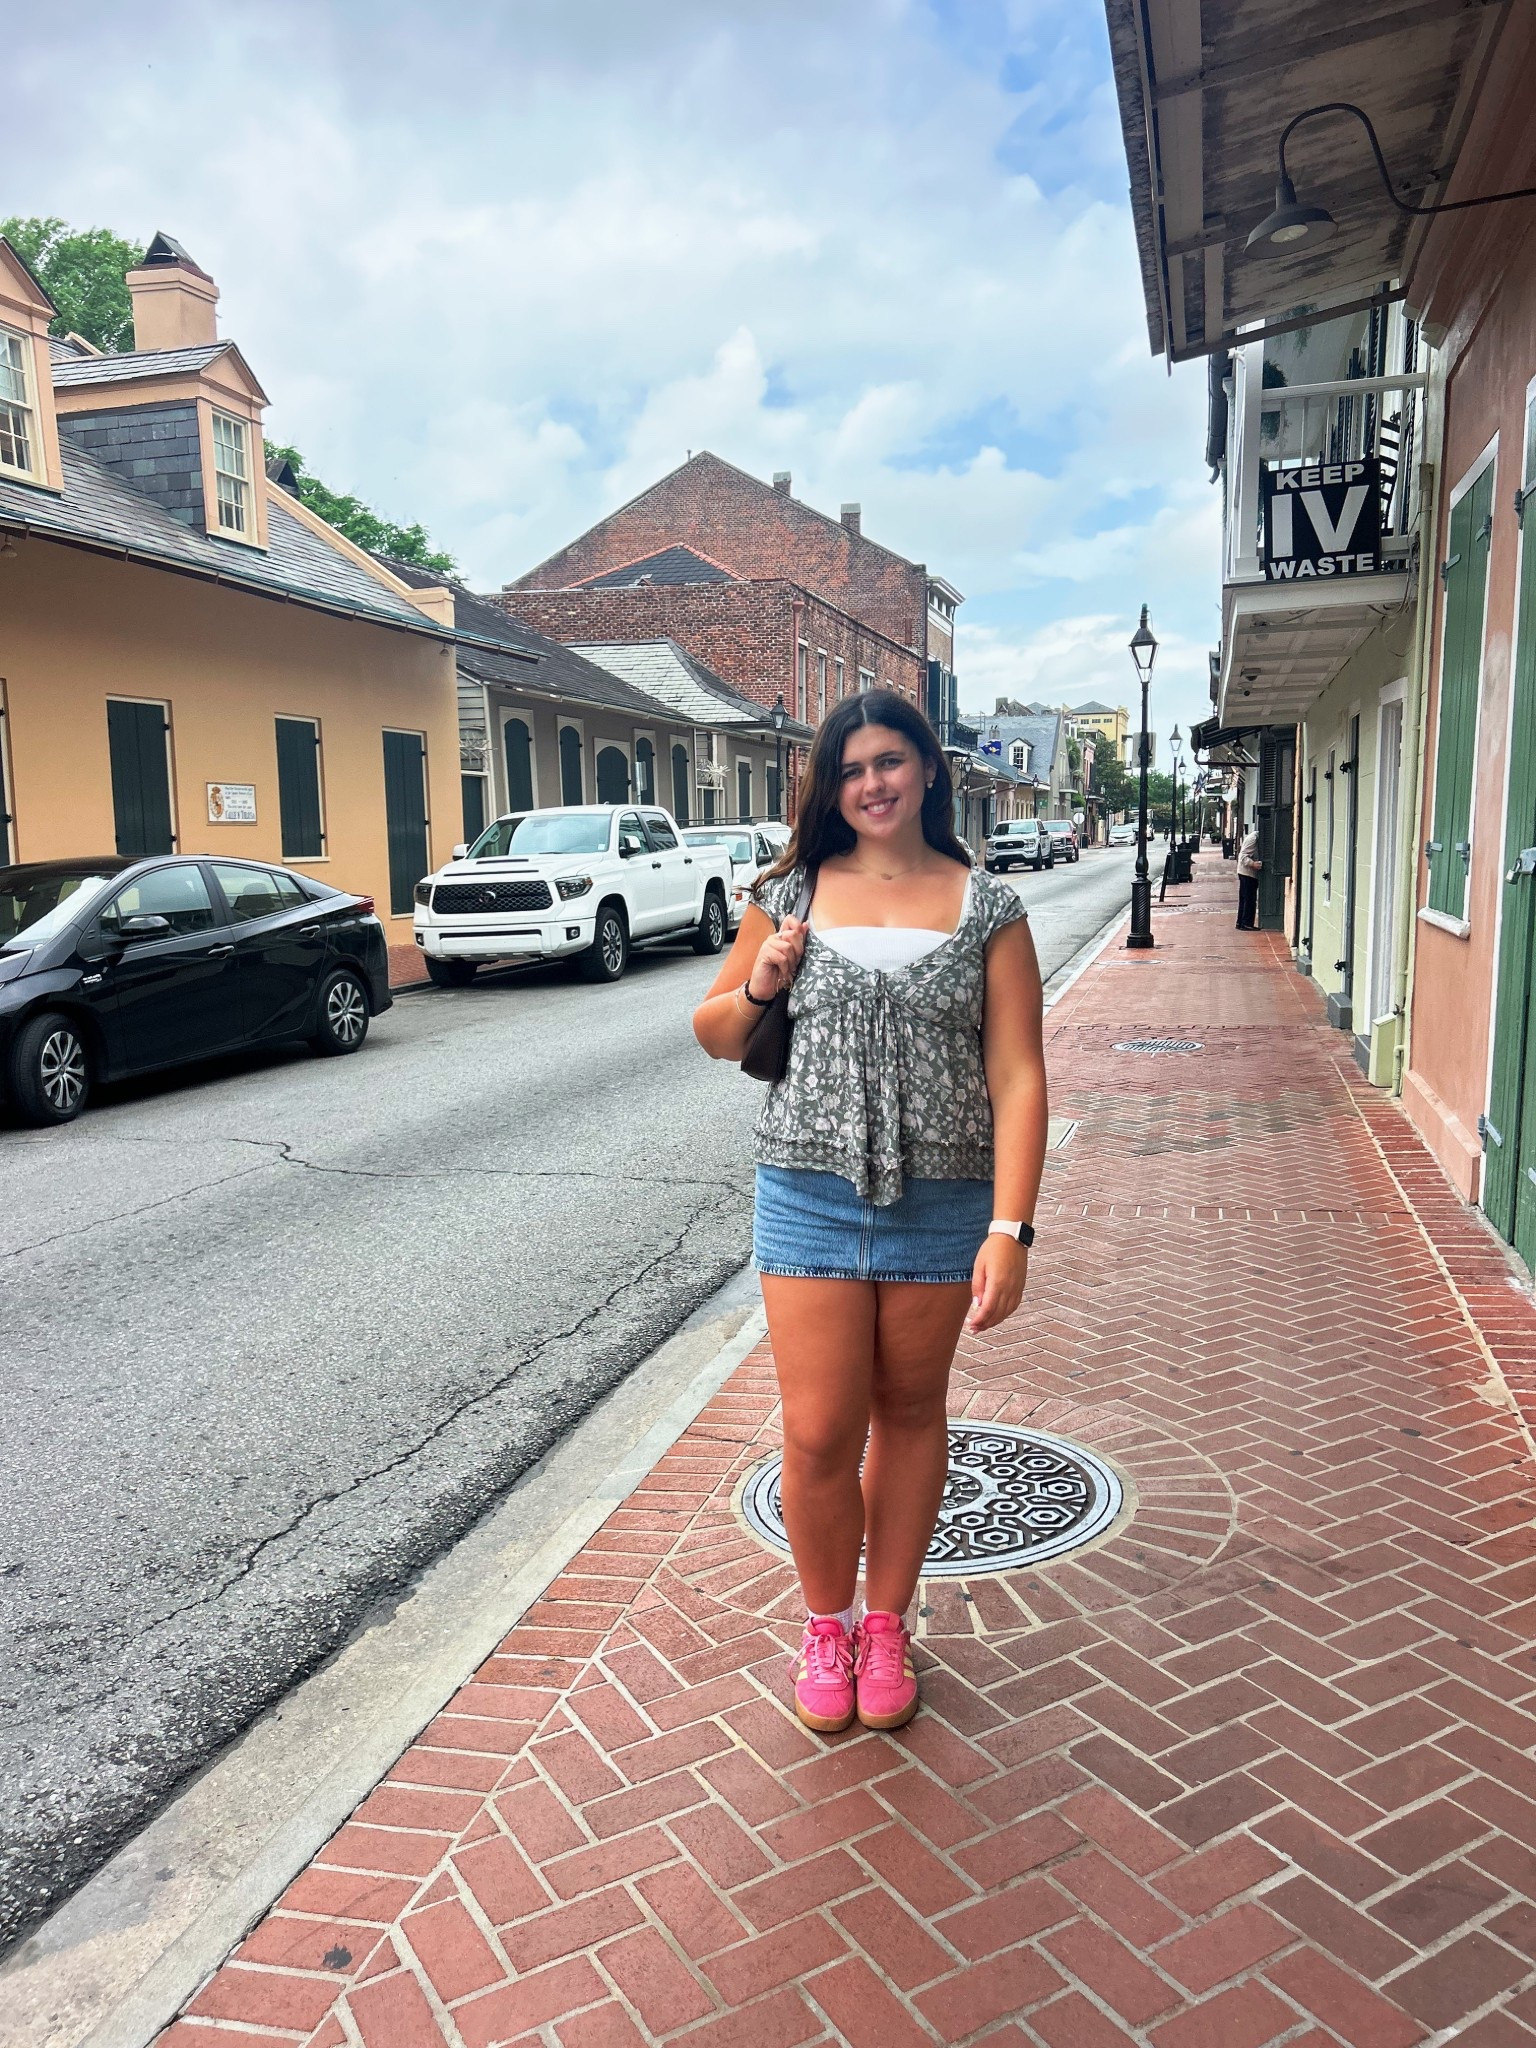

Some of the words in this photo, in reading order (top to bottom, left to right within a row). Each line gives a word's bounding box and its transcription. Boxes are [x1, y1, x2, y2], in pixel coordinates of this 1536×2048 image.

[1277, 463, 1365, 490] KEEP
[1271, 485, 1370, 558] IV
[1269, 552, 1374, 580] WASTE
[943, 1475, 980, 1508] STEM
